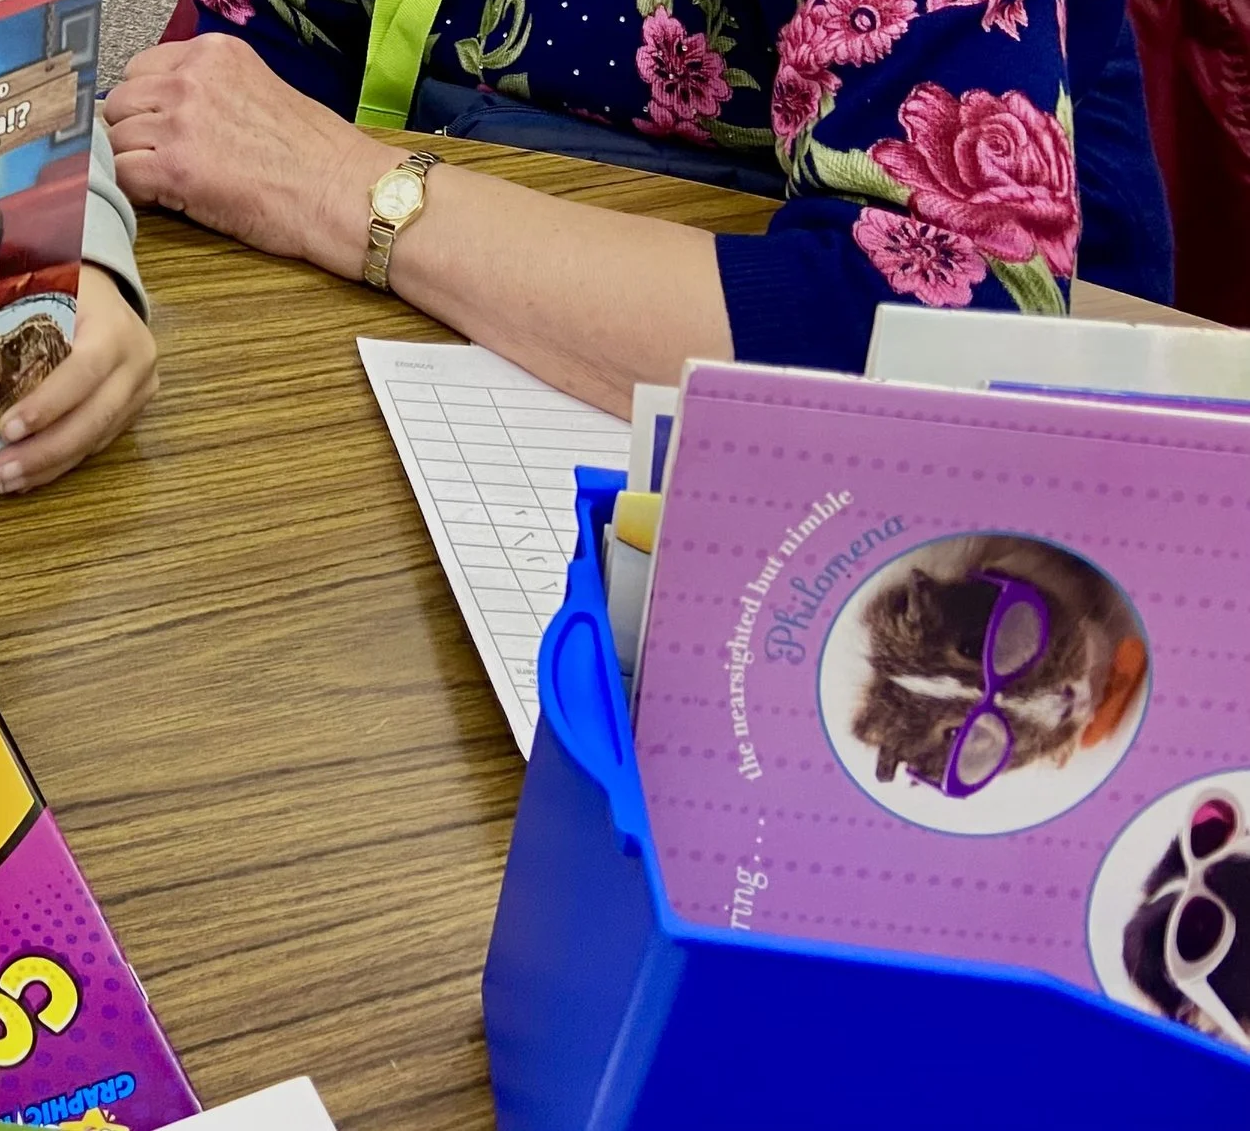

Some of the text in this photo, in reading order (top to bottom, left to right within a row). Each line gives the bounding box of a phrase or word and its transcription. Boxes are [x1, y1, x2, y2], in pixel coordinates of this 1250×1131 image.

[723, 489, 855, 782] the nearsighted but nimble
[764, 513, 906, 666] Philomena
[24, 1074, 137, 1125] GRAPHIC
